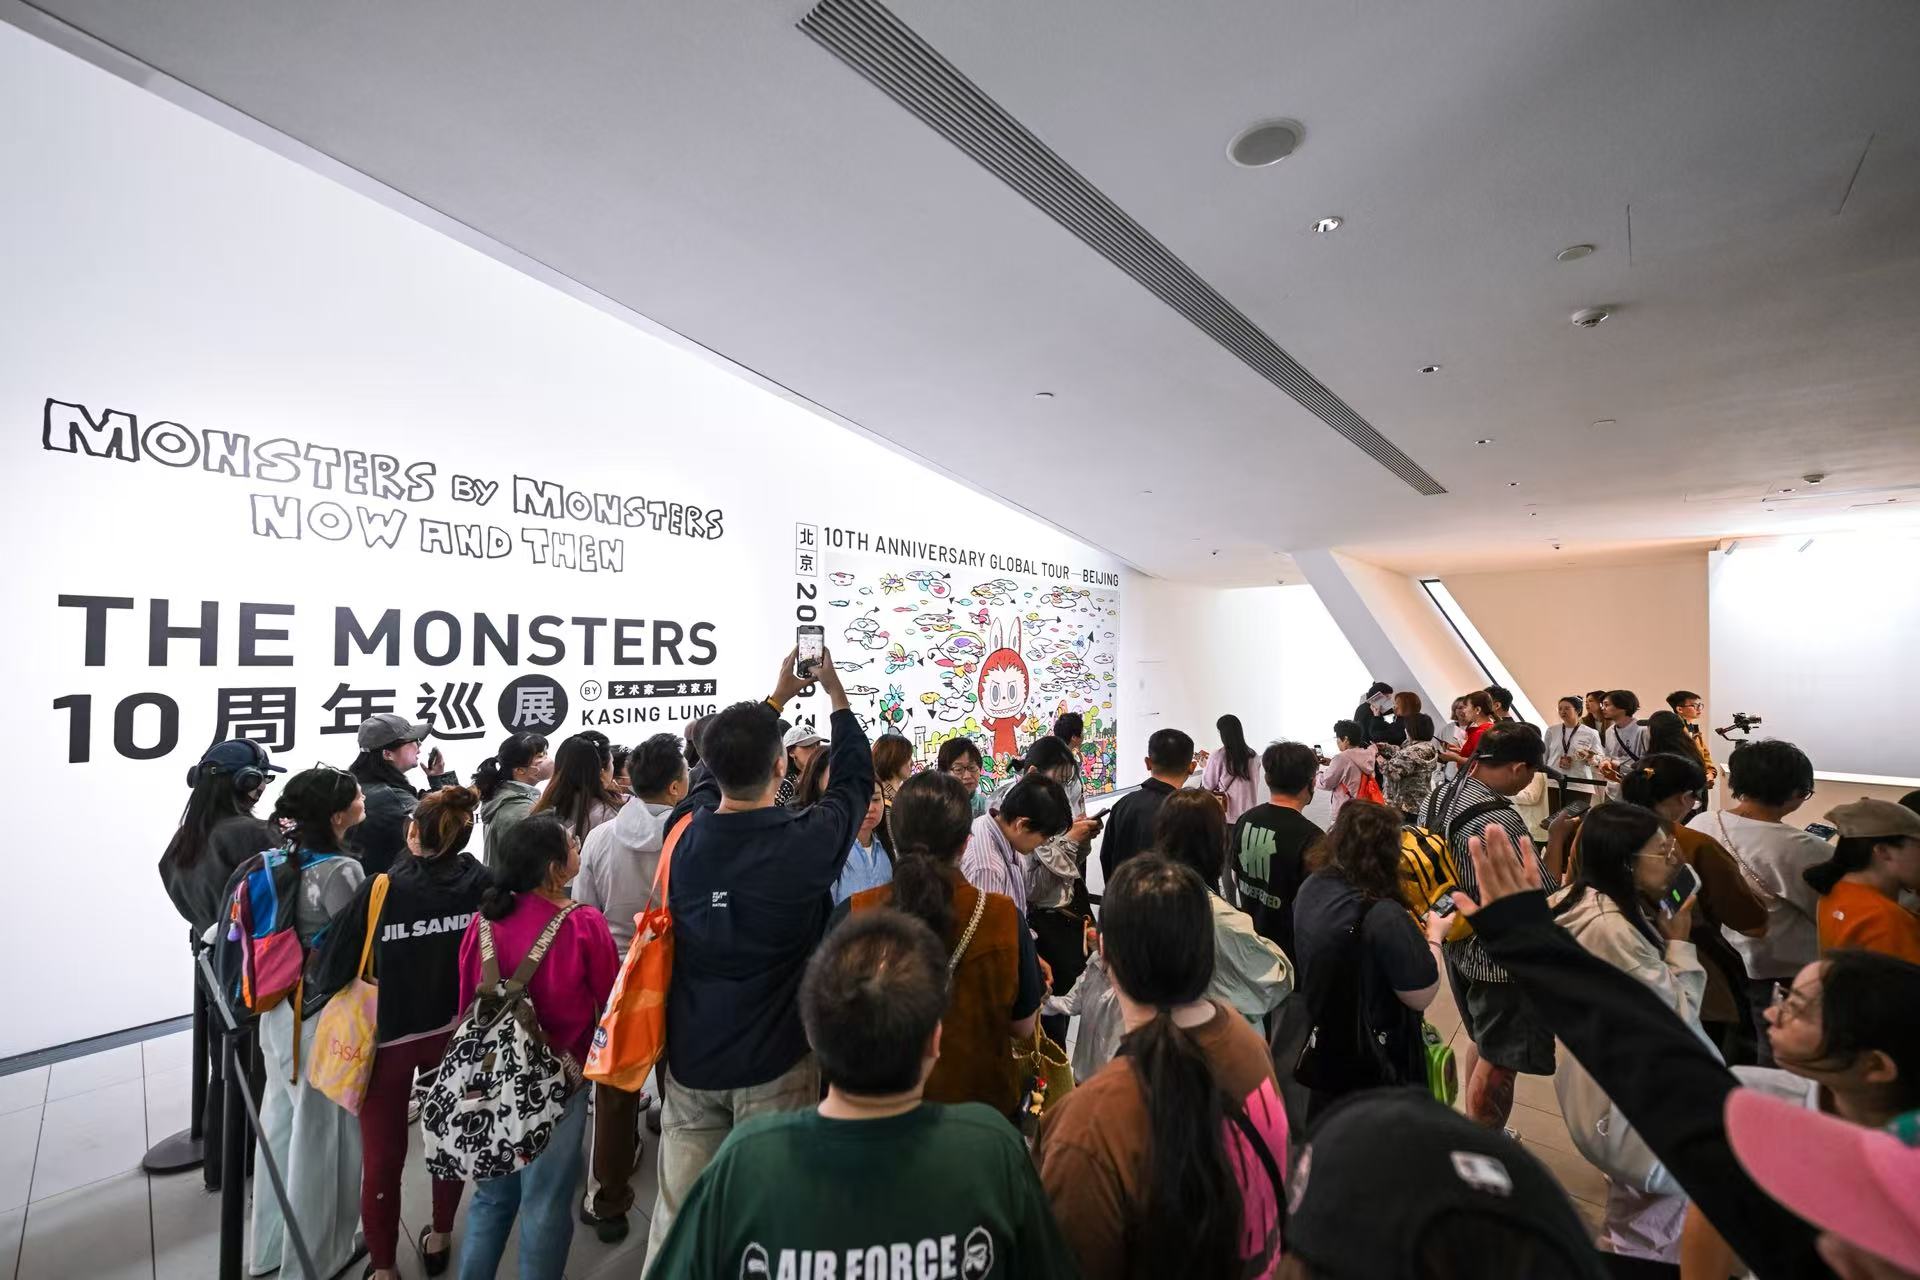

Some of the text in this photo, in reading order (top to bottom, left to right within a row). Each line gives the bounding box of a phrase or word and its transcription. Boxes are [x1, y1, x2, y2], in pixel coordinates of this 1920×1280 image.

[43, 398, 724, 541] MONSTERS BY MONSTERS
[250, 494, 625, 574] NOW AND THEN
[824, 526, 869, 551] 10TH
[875, 535, 985, 568] ANNIVERSARY
[990, 554, 1038, 575] GLOBAL
[57, 594, 719, 668] THE MONSTERS
[584, 686, 598, 695] BY
[581, 706, 661, 726] KASING
[381, 911, 480, 942] JIL SAND
[776, 1234, 957, 1280] AIR FORCE
